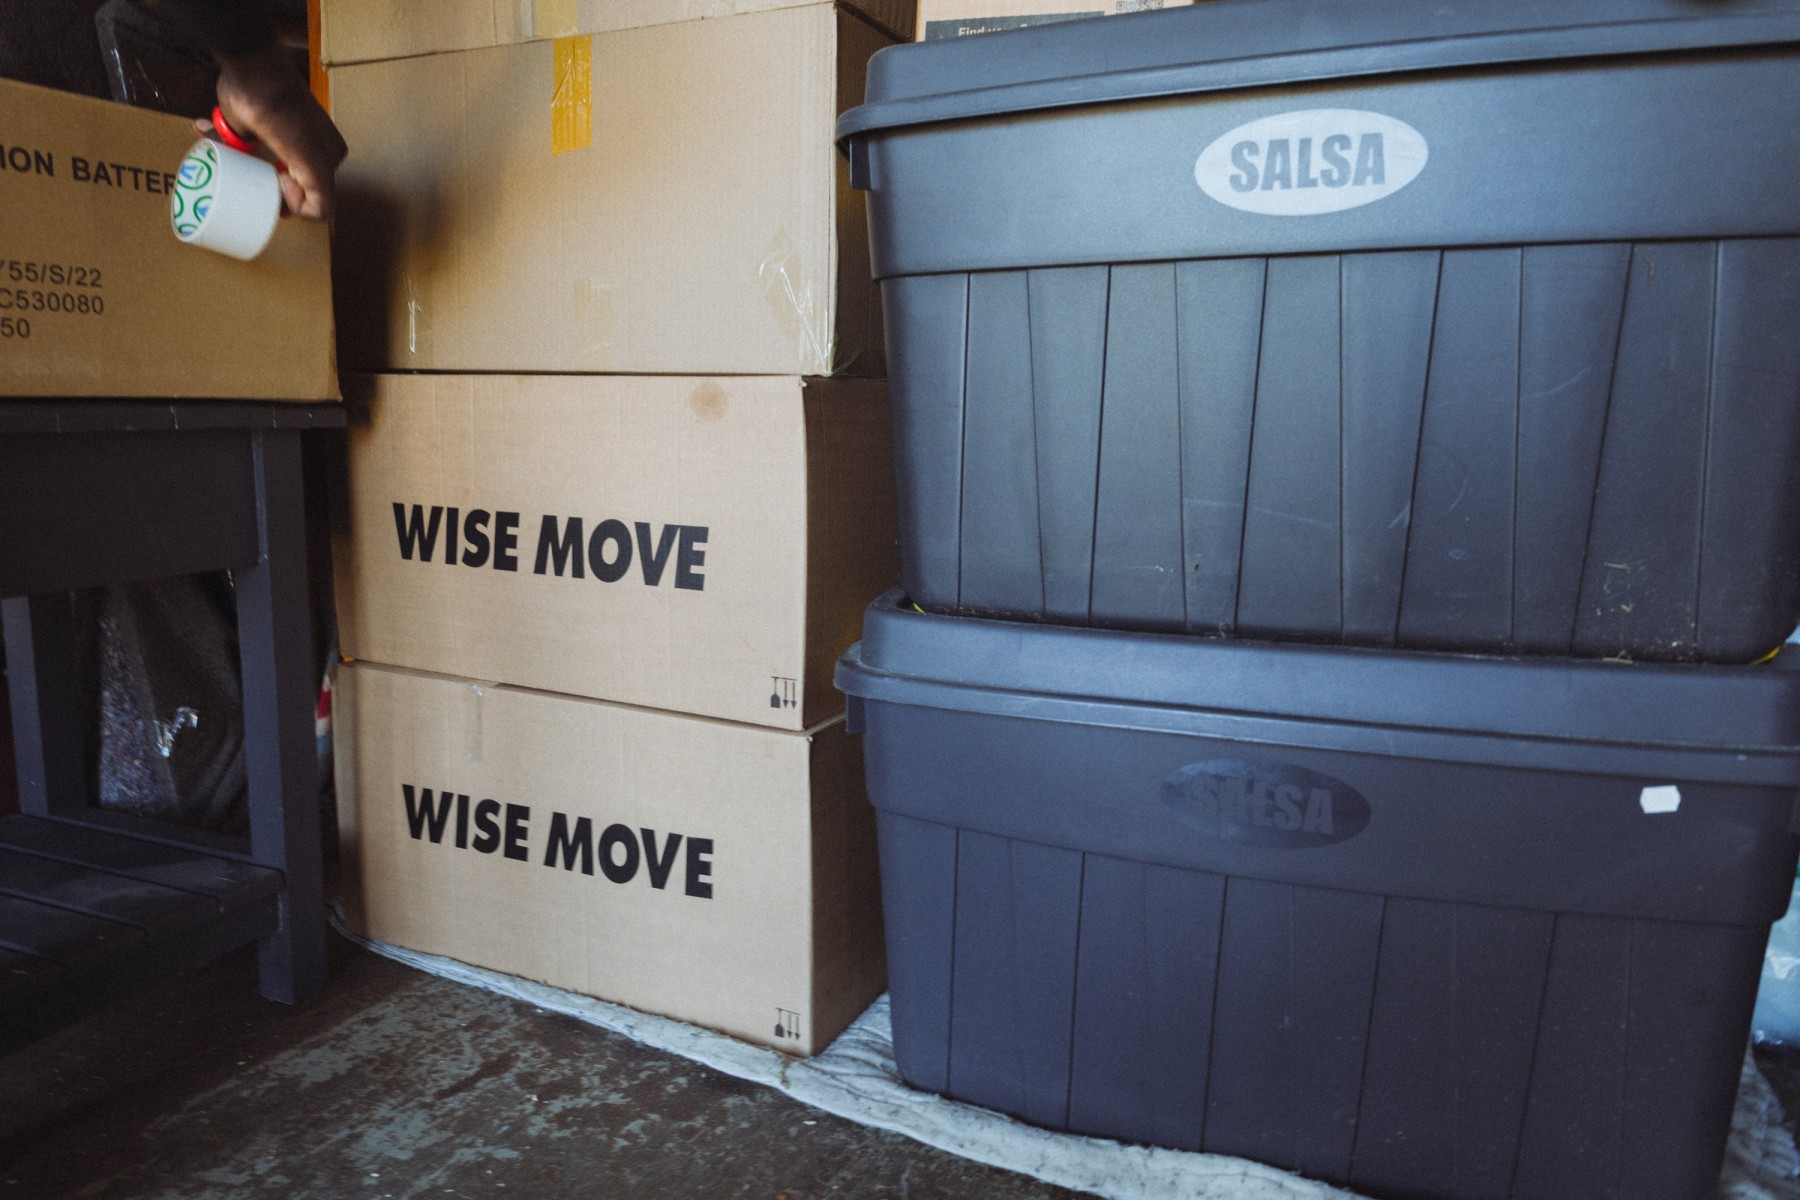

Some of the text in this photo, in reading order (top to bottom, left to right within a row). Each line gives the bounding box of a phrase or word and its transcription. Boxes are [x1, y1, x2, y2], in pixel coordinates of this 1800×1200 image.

[1229, 132, 1386, 193] SALSA
[0, 260, 103, 289] 55/S/22
[392, 502, 709, 591] WISE MOVE
[1190, 774, 1334, 836] SALSA
[402, 783, 714, 900] WISE MOVE
